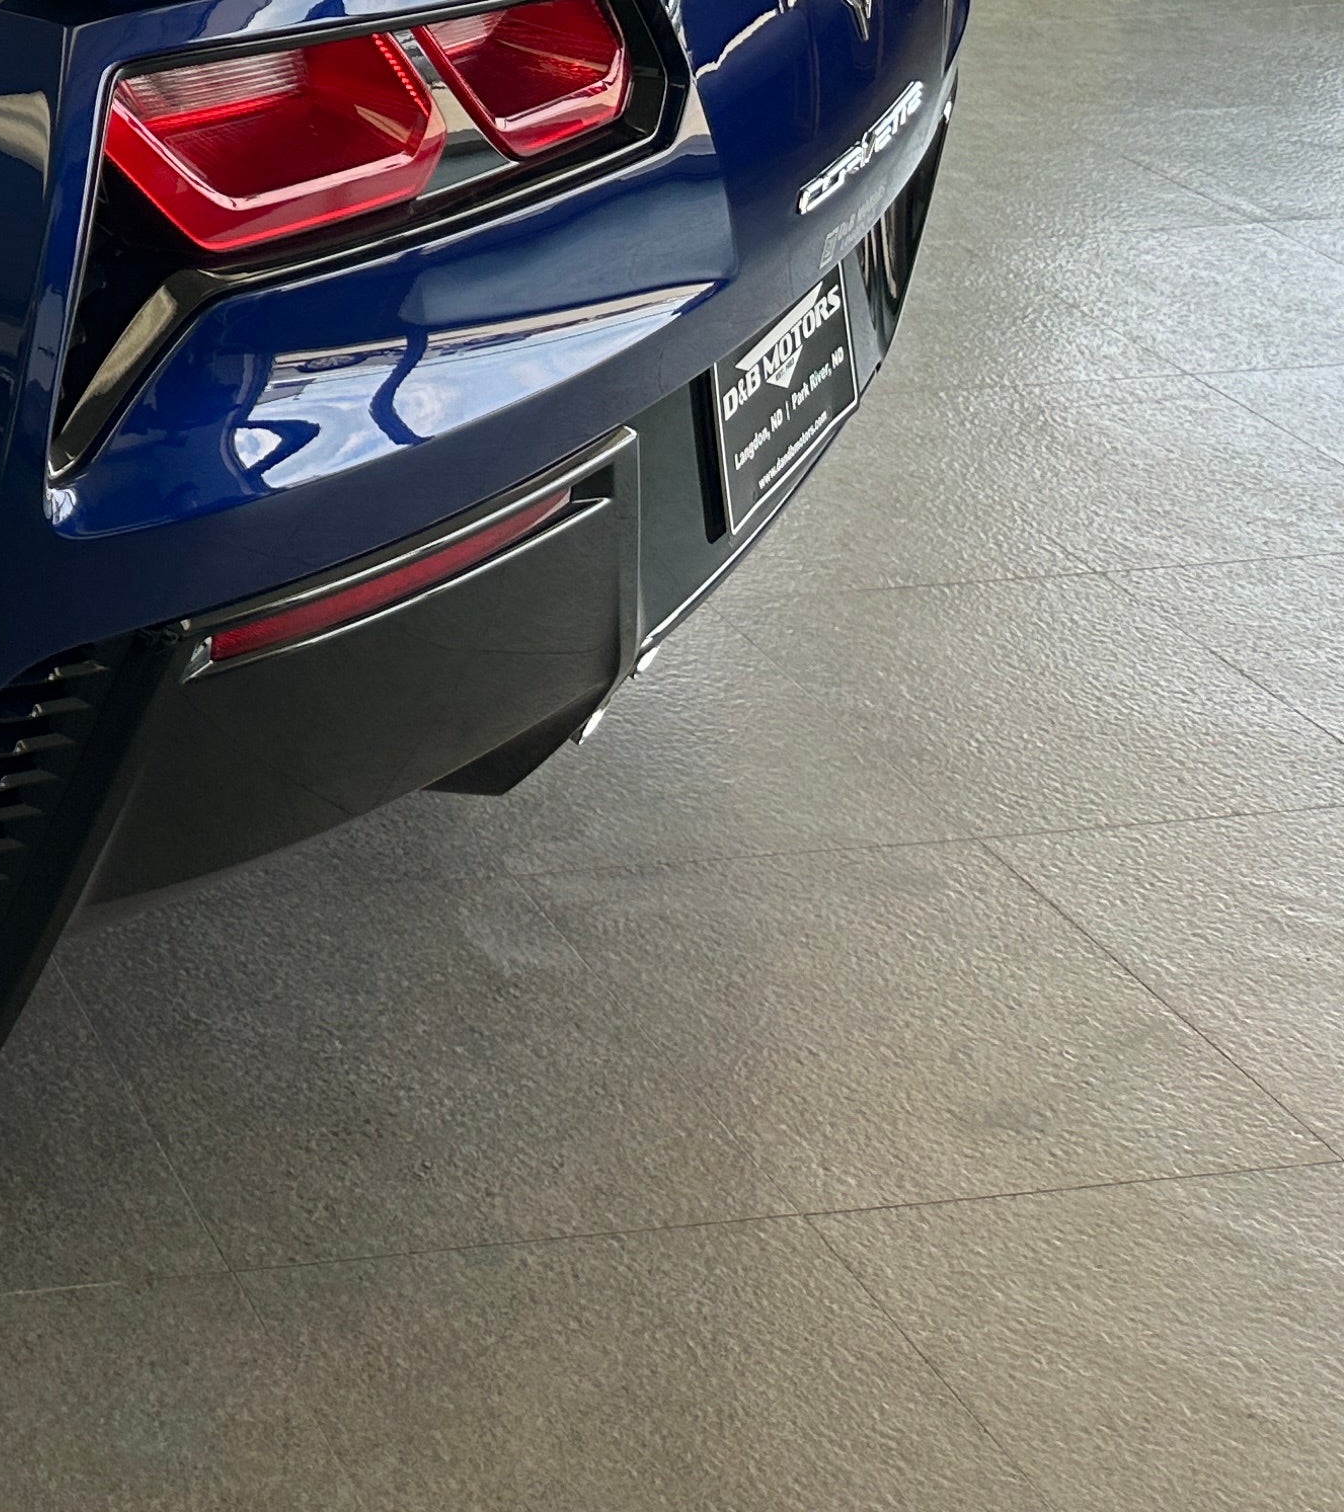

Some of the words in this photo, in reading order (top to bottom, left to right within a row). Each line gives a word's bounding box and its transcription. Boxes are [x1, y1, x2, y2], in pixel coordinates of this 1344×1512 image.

[723, 364, 761, 421] D&B
[763, 284, 842, 379] MOTORS
[735, 430, 771, 471] Langdon,
[770, 408, 783, 432] ND
[791, 382, 811, 410] Park
[831, 346, 844, 369] ND
